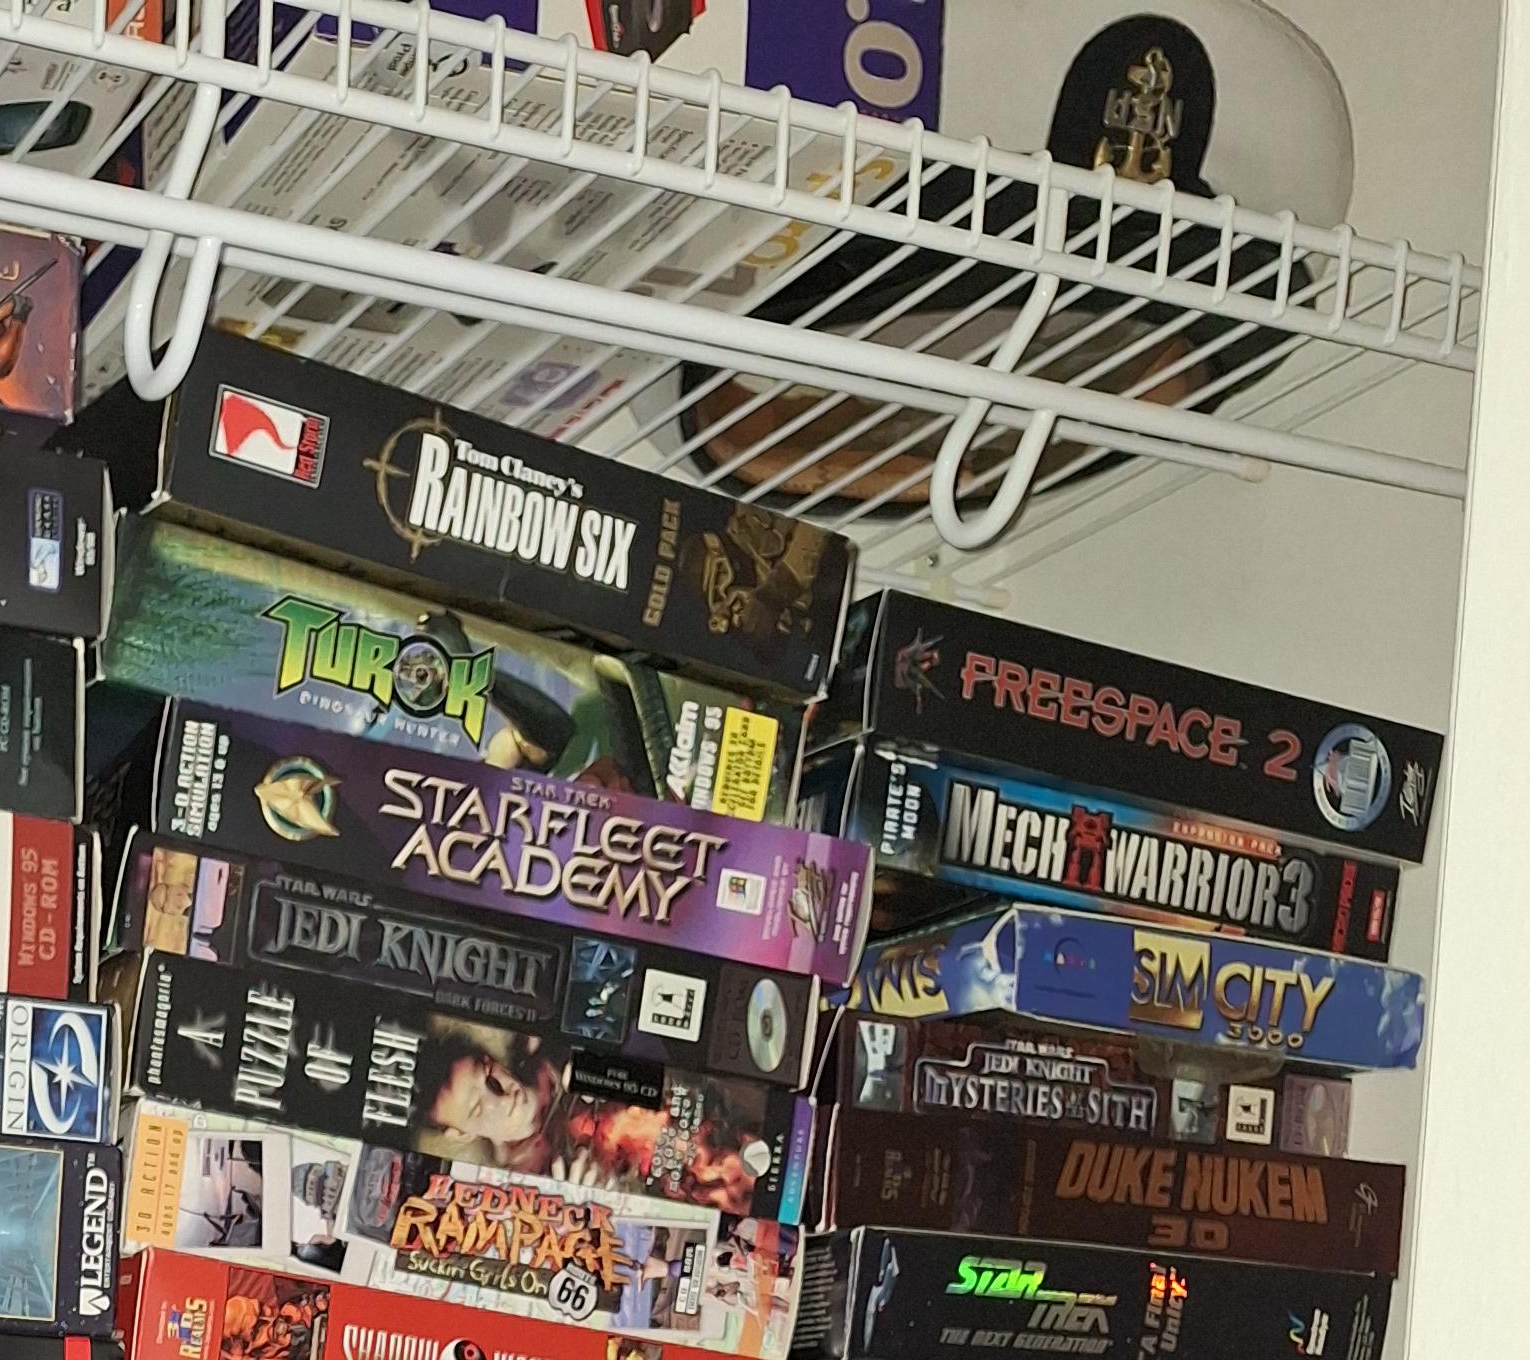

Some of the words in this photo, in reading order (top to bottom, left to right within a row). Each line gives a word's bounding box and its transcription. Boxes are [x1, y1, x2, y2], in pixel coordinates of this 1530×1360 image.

[408, 433, 581, 575] RAINBOW
[575, 510, 639, 590] SIX
[262, 597, 497, 751] TUROK
[960, 650, 1246, 768] FREESPACE
[1263, 729, 1303, 781] 2
[379, 768, 729, 878] STARFLEET
[391, 823, 695, 919] ACADEMY
[176, 1014, 226, 1067] A
[235, 985, 296, 1110] PUZZLE
[304, 1028, 354, 1090] OF
[364, 1015, 424, 1127] FLESH
[1214, 960, 1337, 1026] CITY
